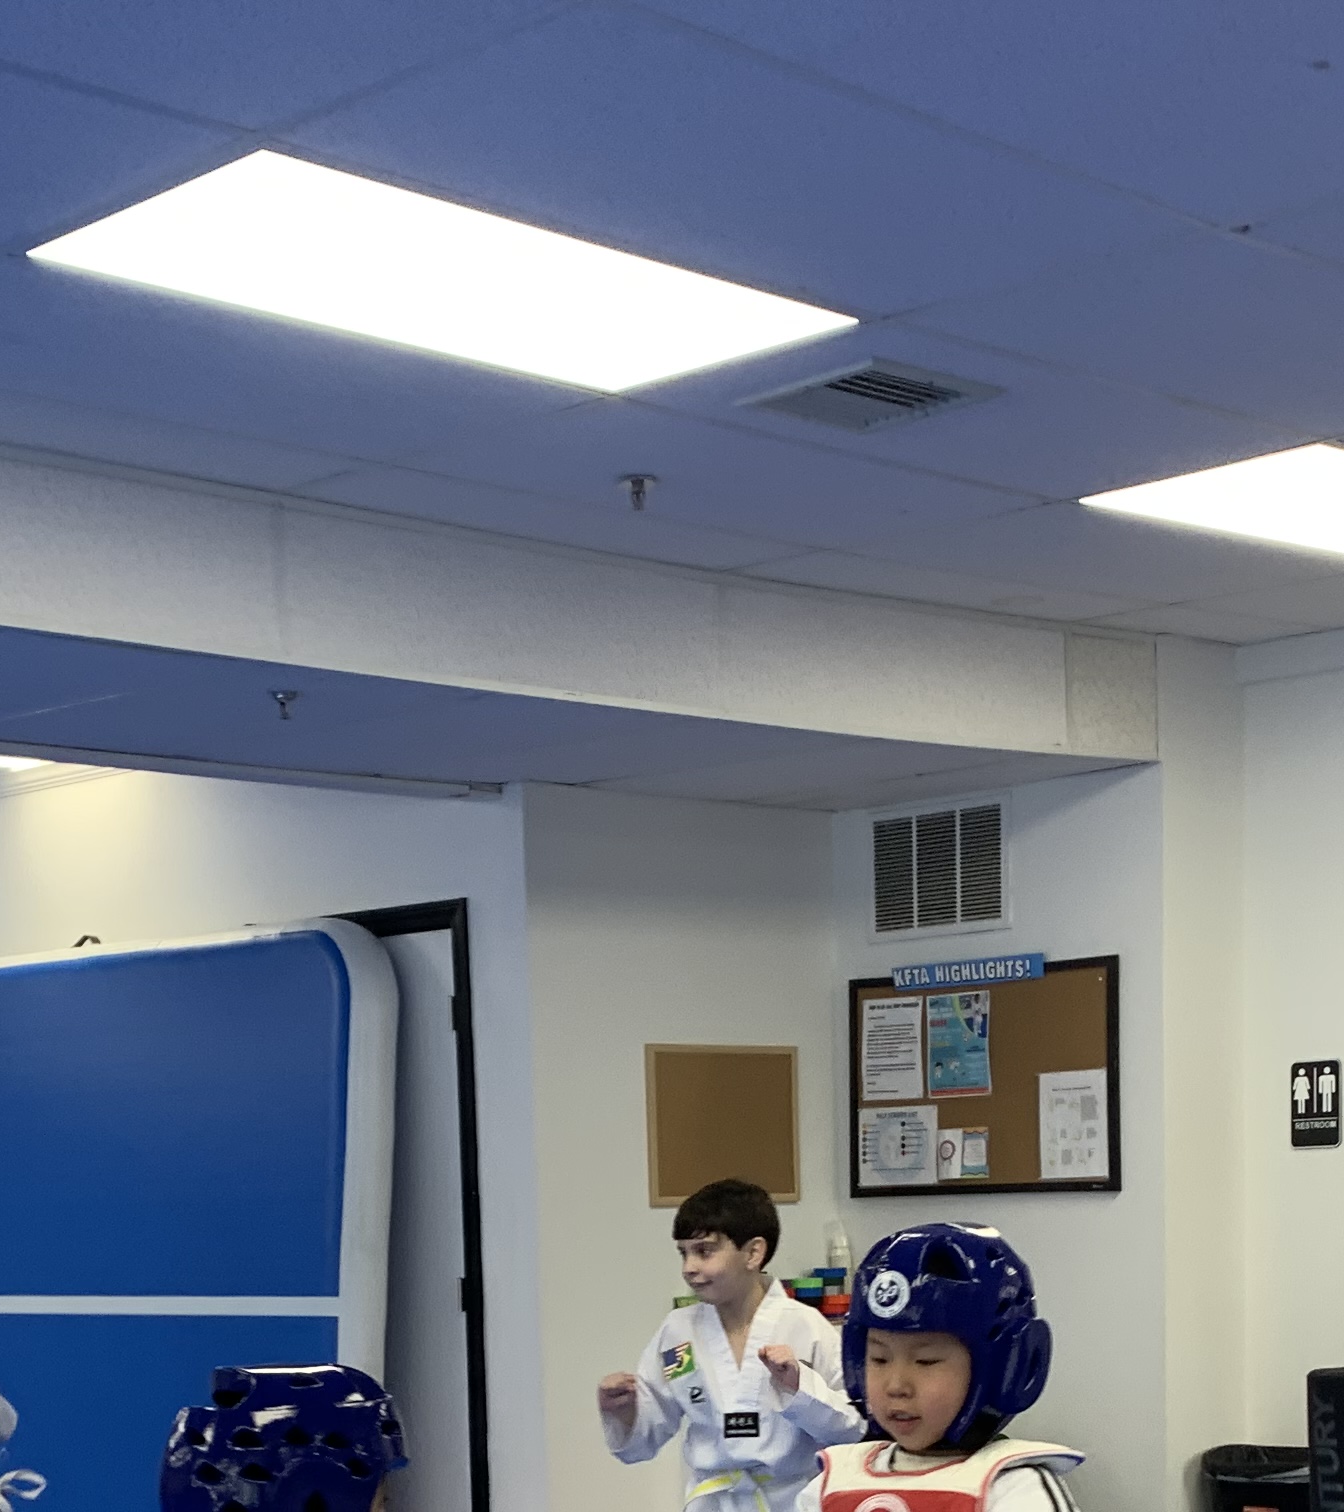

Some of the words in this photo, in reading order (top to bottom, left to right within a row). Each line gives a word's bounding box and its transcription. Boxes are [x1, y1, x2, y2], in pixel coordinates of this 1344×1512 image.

[893, 967, 930, 987] KFTA
[935, 959, 1031, 983] HIGHLIGHTS!
[1295, 1120, 1337, 1130] RESTROOM
